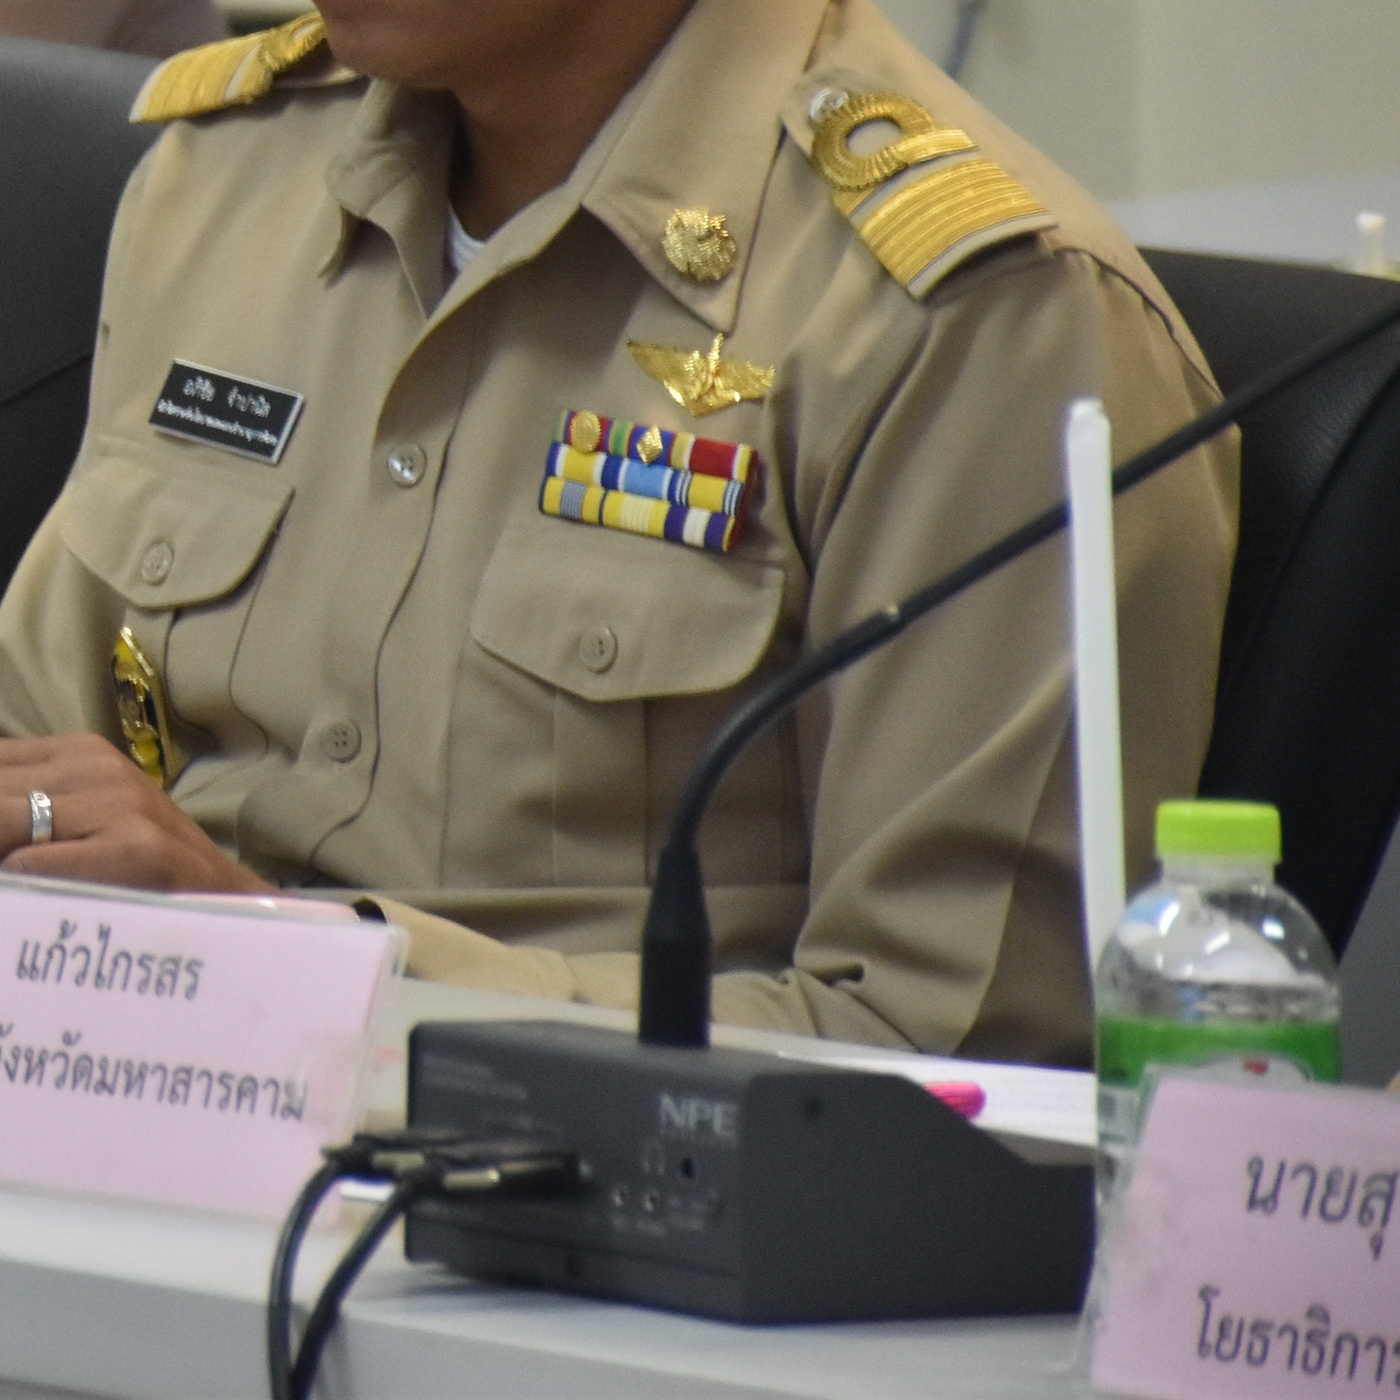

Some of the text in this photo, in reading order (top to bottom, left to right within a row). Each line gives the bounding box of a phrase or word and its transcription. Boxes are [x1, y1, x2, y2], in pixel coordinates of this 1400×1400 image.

[16, 919, 205, 1002] แก้วไกรสร
[659, 1091, 739, 1138] NPE
